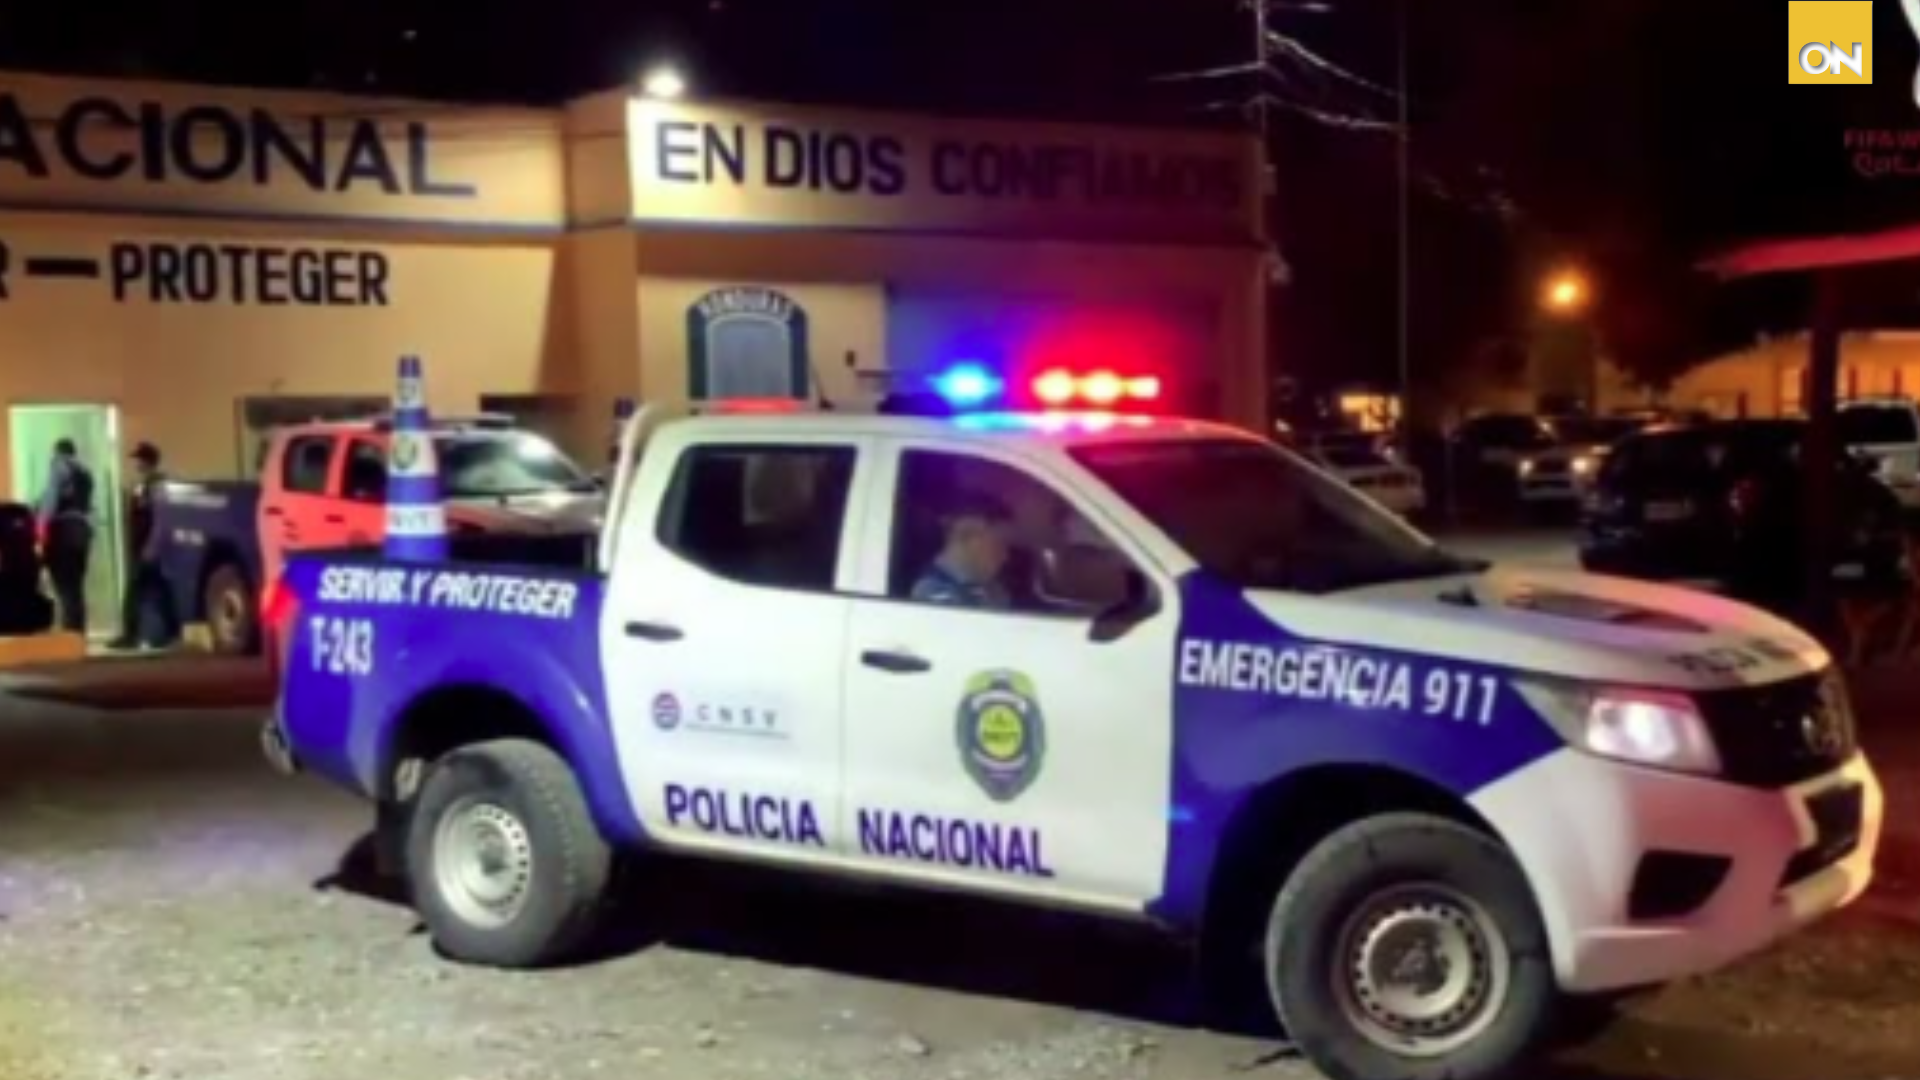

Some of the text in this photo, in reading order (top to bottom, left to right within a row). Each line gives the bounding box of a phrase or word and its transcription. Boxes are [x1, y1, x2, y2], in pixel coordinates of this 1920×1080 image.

[0, 92, 476, 196] ACIONAL
[655, 121, 745, 186] EN
[765, 127, 906, 195] DIOS
[110, 242, 388, 305] PROTEGER
[411, 570, 433, 604] Y
[430, 572, 577, 619] PROTEGER
[310, 616, 374, 675] T-243
[1179, 638, 1496, 725] EMERGENCIA 911
[664, 783, 1055, 878] POLICIA NACIONAL
